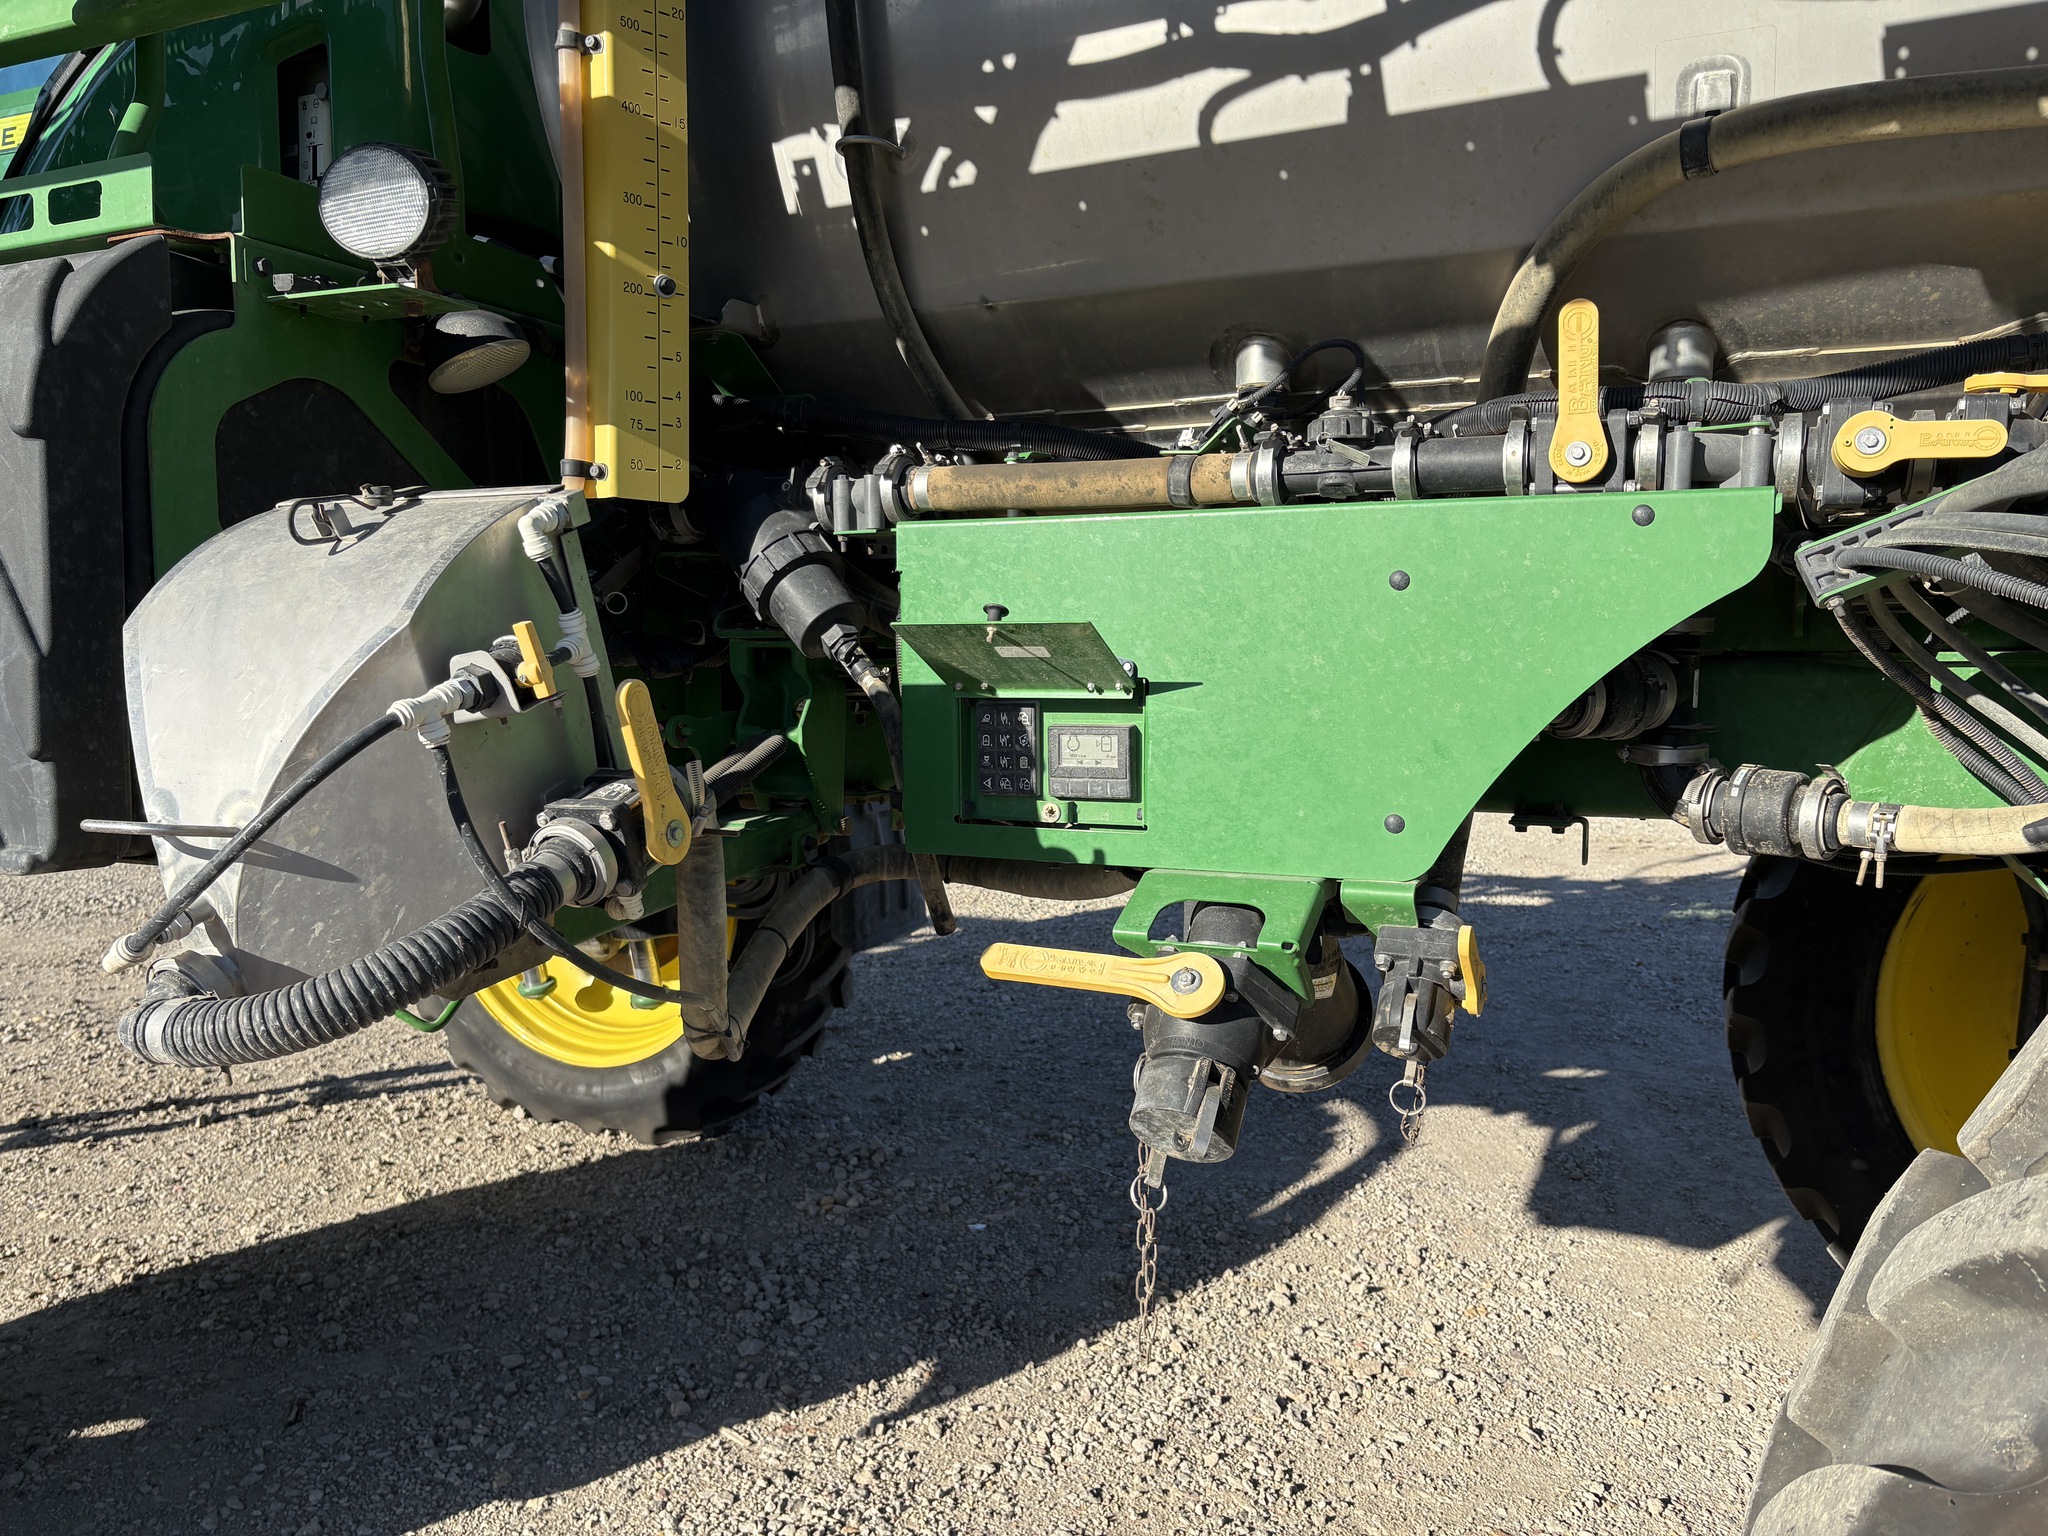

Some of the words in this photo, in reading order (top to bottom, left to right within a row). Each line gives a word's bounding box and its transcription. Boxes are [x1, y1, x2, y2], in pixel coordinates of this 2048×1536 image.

[671, 7, 685, 21] 20
[619, 15, 640, 31] 500
[621, 100, 641, 115] 400
[673, 117, 686, 130] 15
[622, 191, 643, 206] 300
[675, 236, 688, 248] 10
[623, 281, 643, 295] 200
[675, 351, 682, 362] 5
[624, 389, 643, 402] 100
[675, 391, 682, 402] 4
[630, 418, 643, 430] 75
[675, 417, 682, 429] 3
[630, 459, 643, 471] 50
[675, 459, 682, 470] 2
